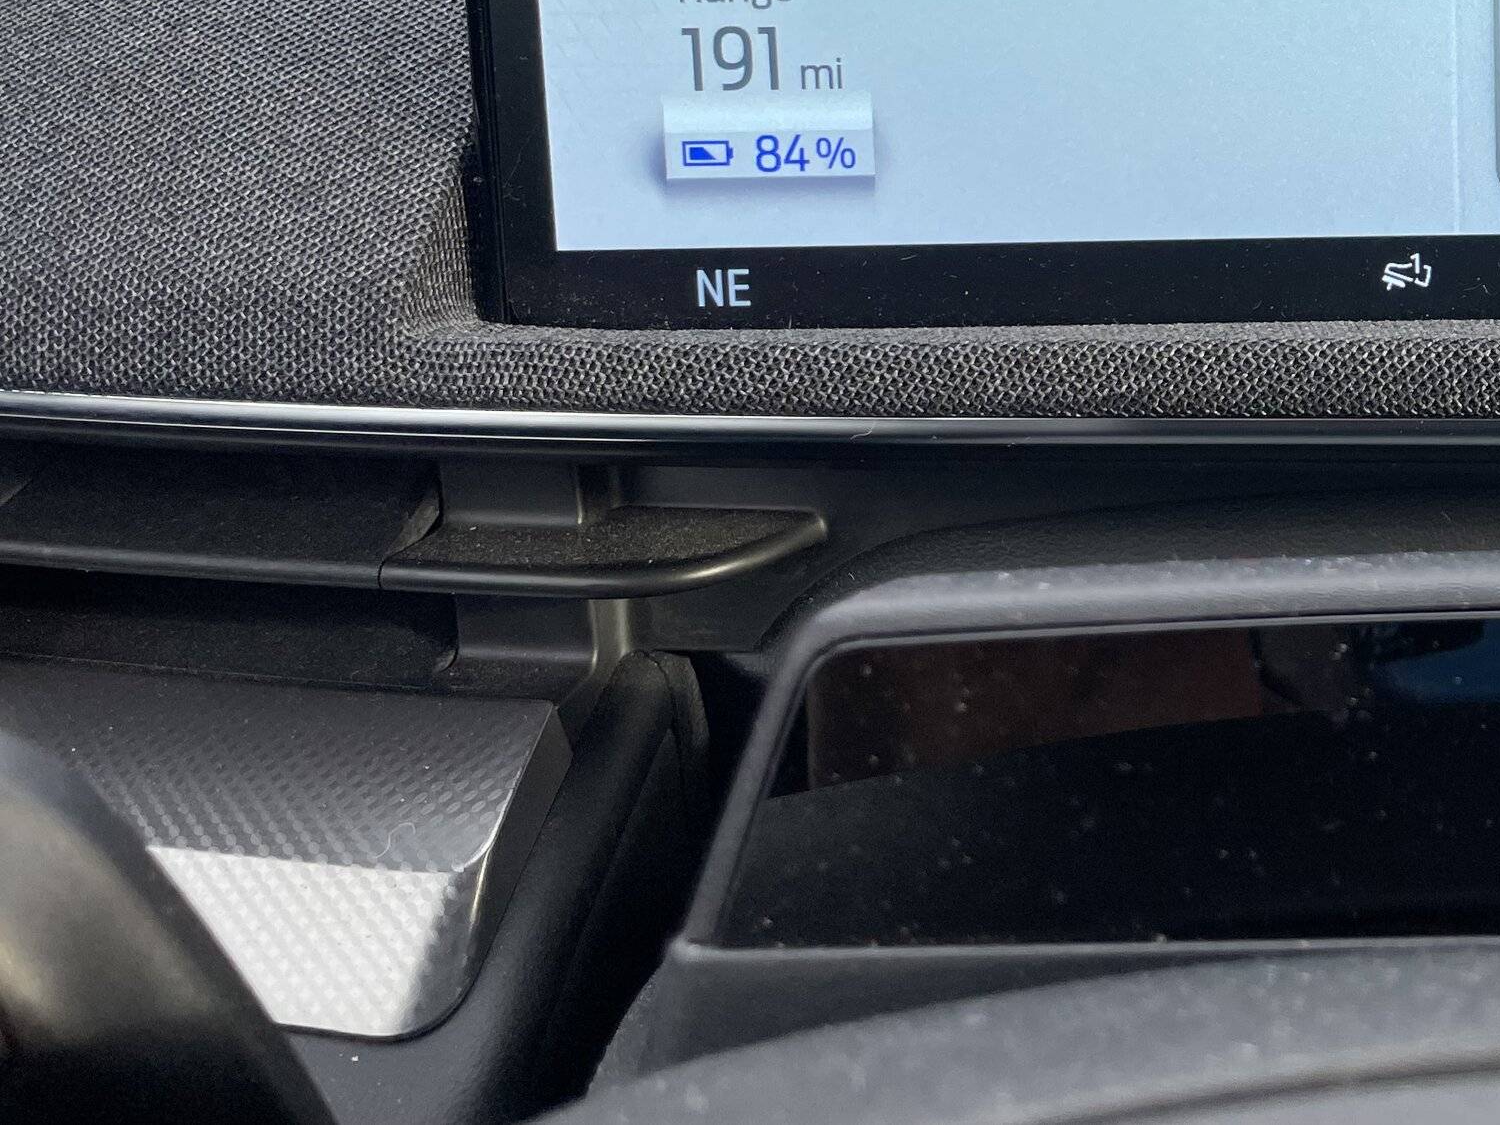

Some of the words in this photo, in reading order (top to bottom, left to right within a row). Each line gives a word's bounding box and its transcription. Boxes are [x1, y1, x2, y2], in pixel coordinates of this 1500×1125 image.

[681, 25, 781, 92] 191
[800, 57, 844, 90] mi
[755, 134, 856, 173] 84%
[696, 268, 751, 307] NE
